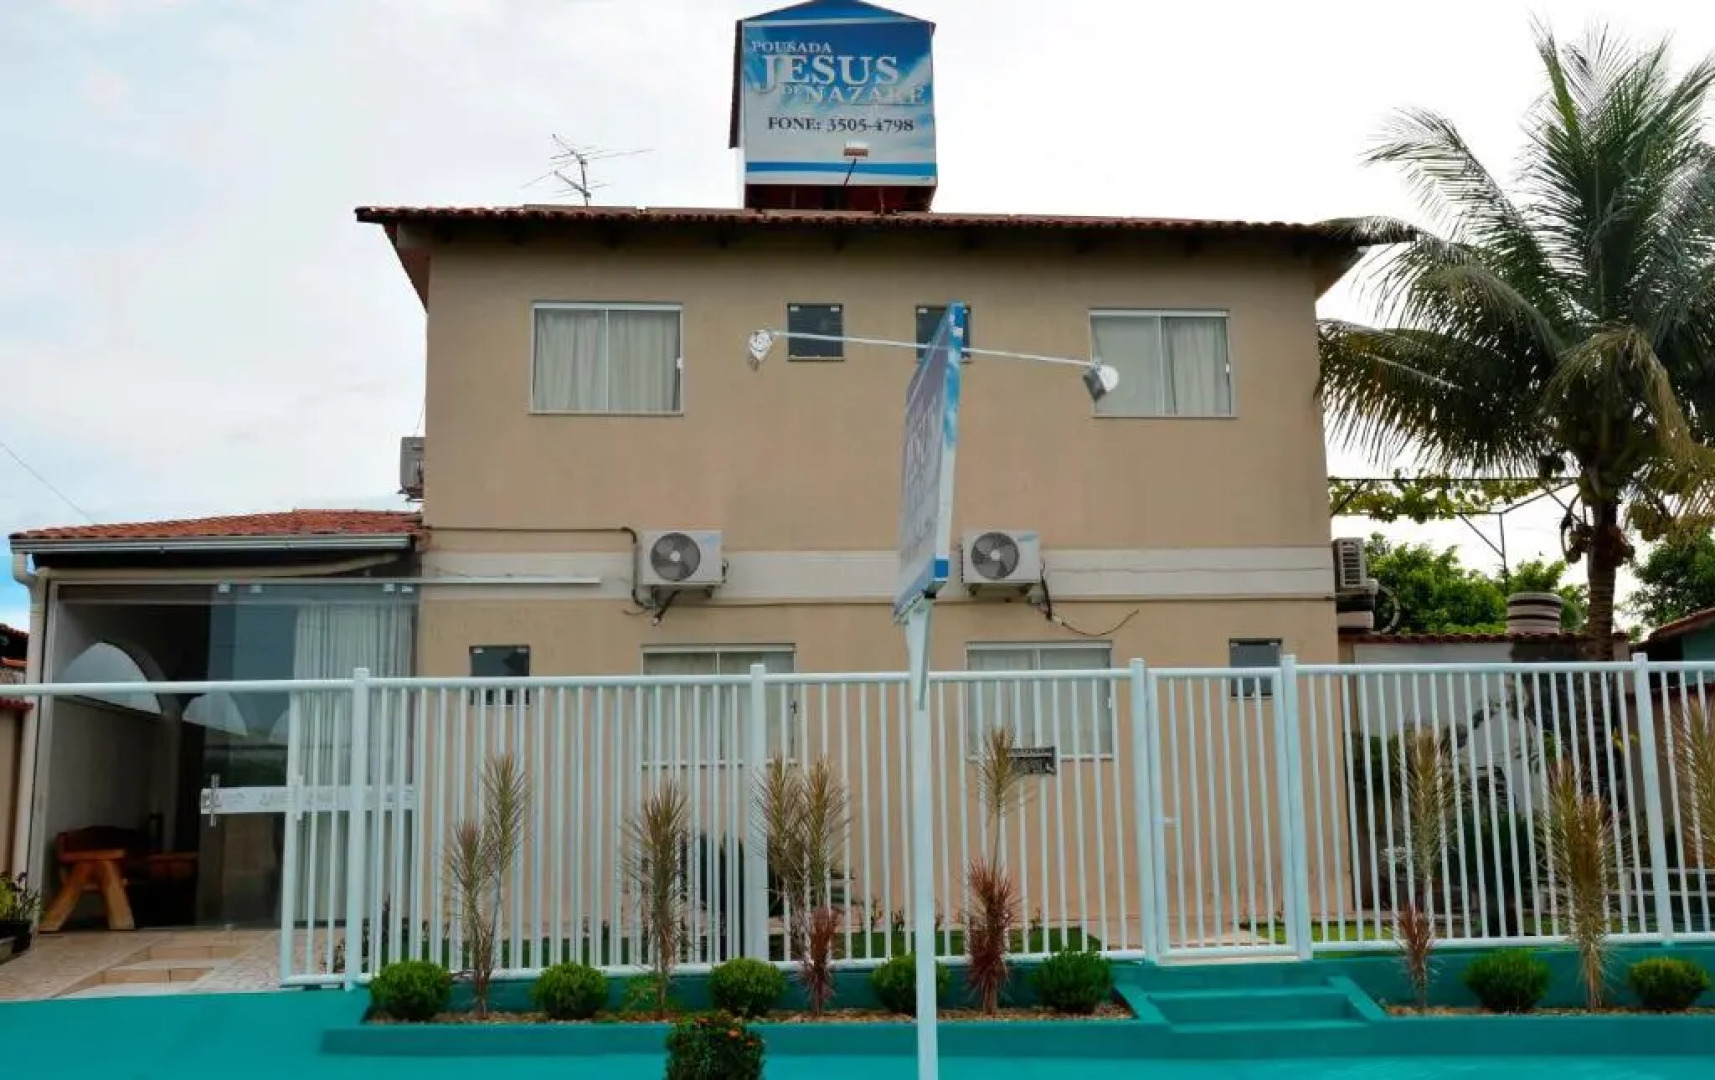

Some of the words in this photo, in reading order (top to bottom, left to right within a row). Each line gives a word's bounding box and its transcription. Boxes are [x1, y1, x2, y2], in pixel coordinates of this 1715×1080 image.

[751, 41, 832, 53] POUSADA
[756, 54, 899, 93] JESUS
[767, 117, 821, 130] FONE:
[826, 118, 914, 132] 3505-4798
